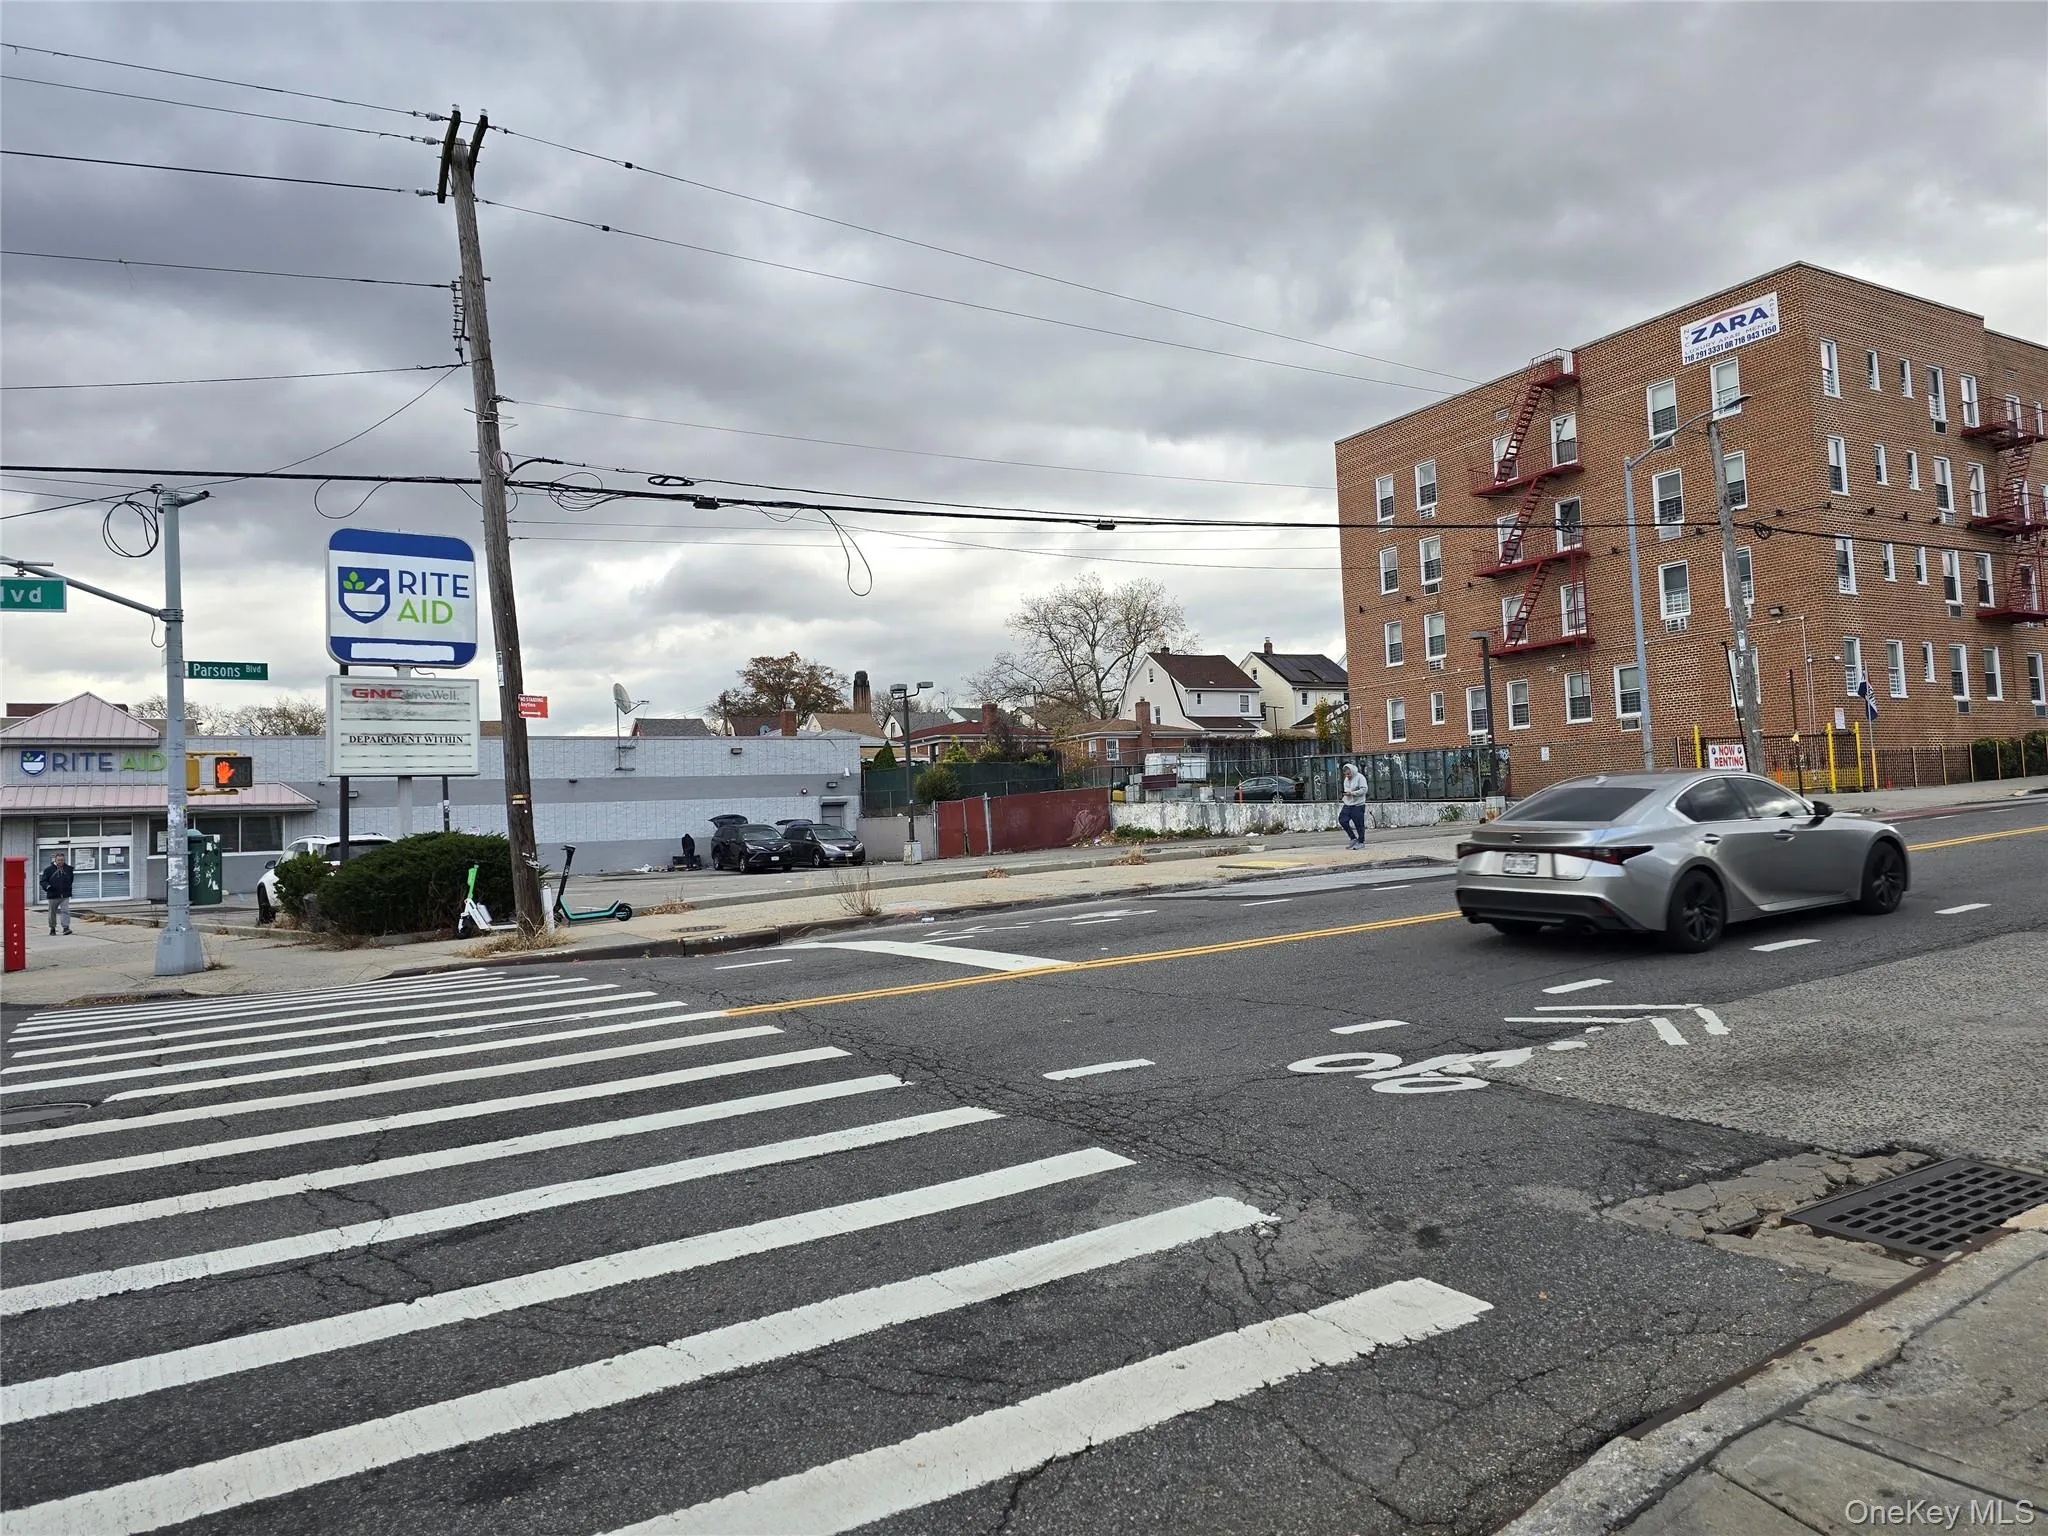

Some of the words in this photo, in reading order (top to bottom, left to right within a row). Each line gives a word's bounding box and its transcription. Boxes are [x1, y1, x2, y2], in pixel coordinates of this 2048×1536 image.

[1691, 307, 1769, 344] ZARA
[1696, 349, 1707, 360] 291
[1708, 343, 1724, 356] 3331
[1724, 339, 1734, 350] OR
[1747, 329, 1760, 342] 943
[398, 569, 470, 599] RITE
[397, 598, 453, 625] AID
[193, 663, 241, 677] Parsons
[246, 664, 261, 673] Blvd
[351, 688, 404, 700] GNC
[349, 735, 421, 744] DEPARTMENT
[424, 736, 464, 744] WITHIN
[1719, 746, 1735, 756] NOW
[52, 752, 113, 772] RITE
[120, 752, 167, 772] AID
[1714, 756, 1744, 767] RENTING
